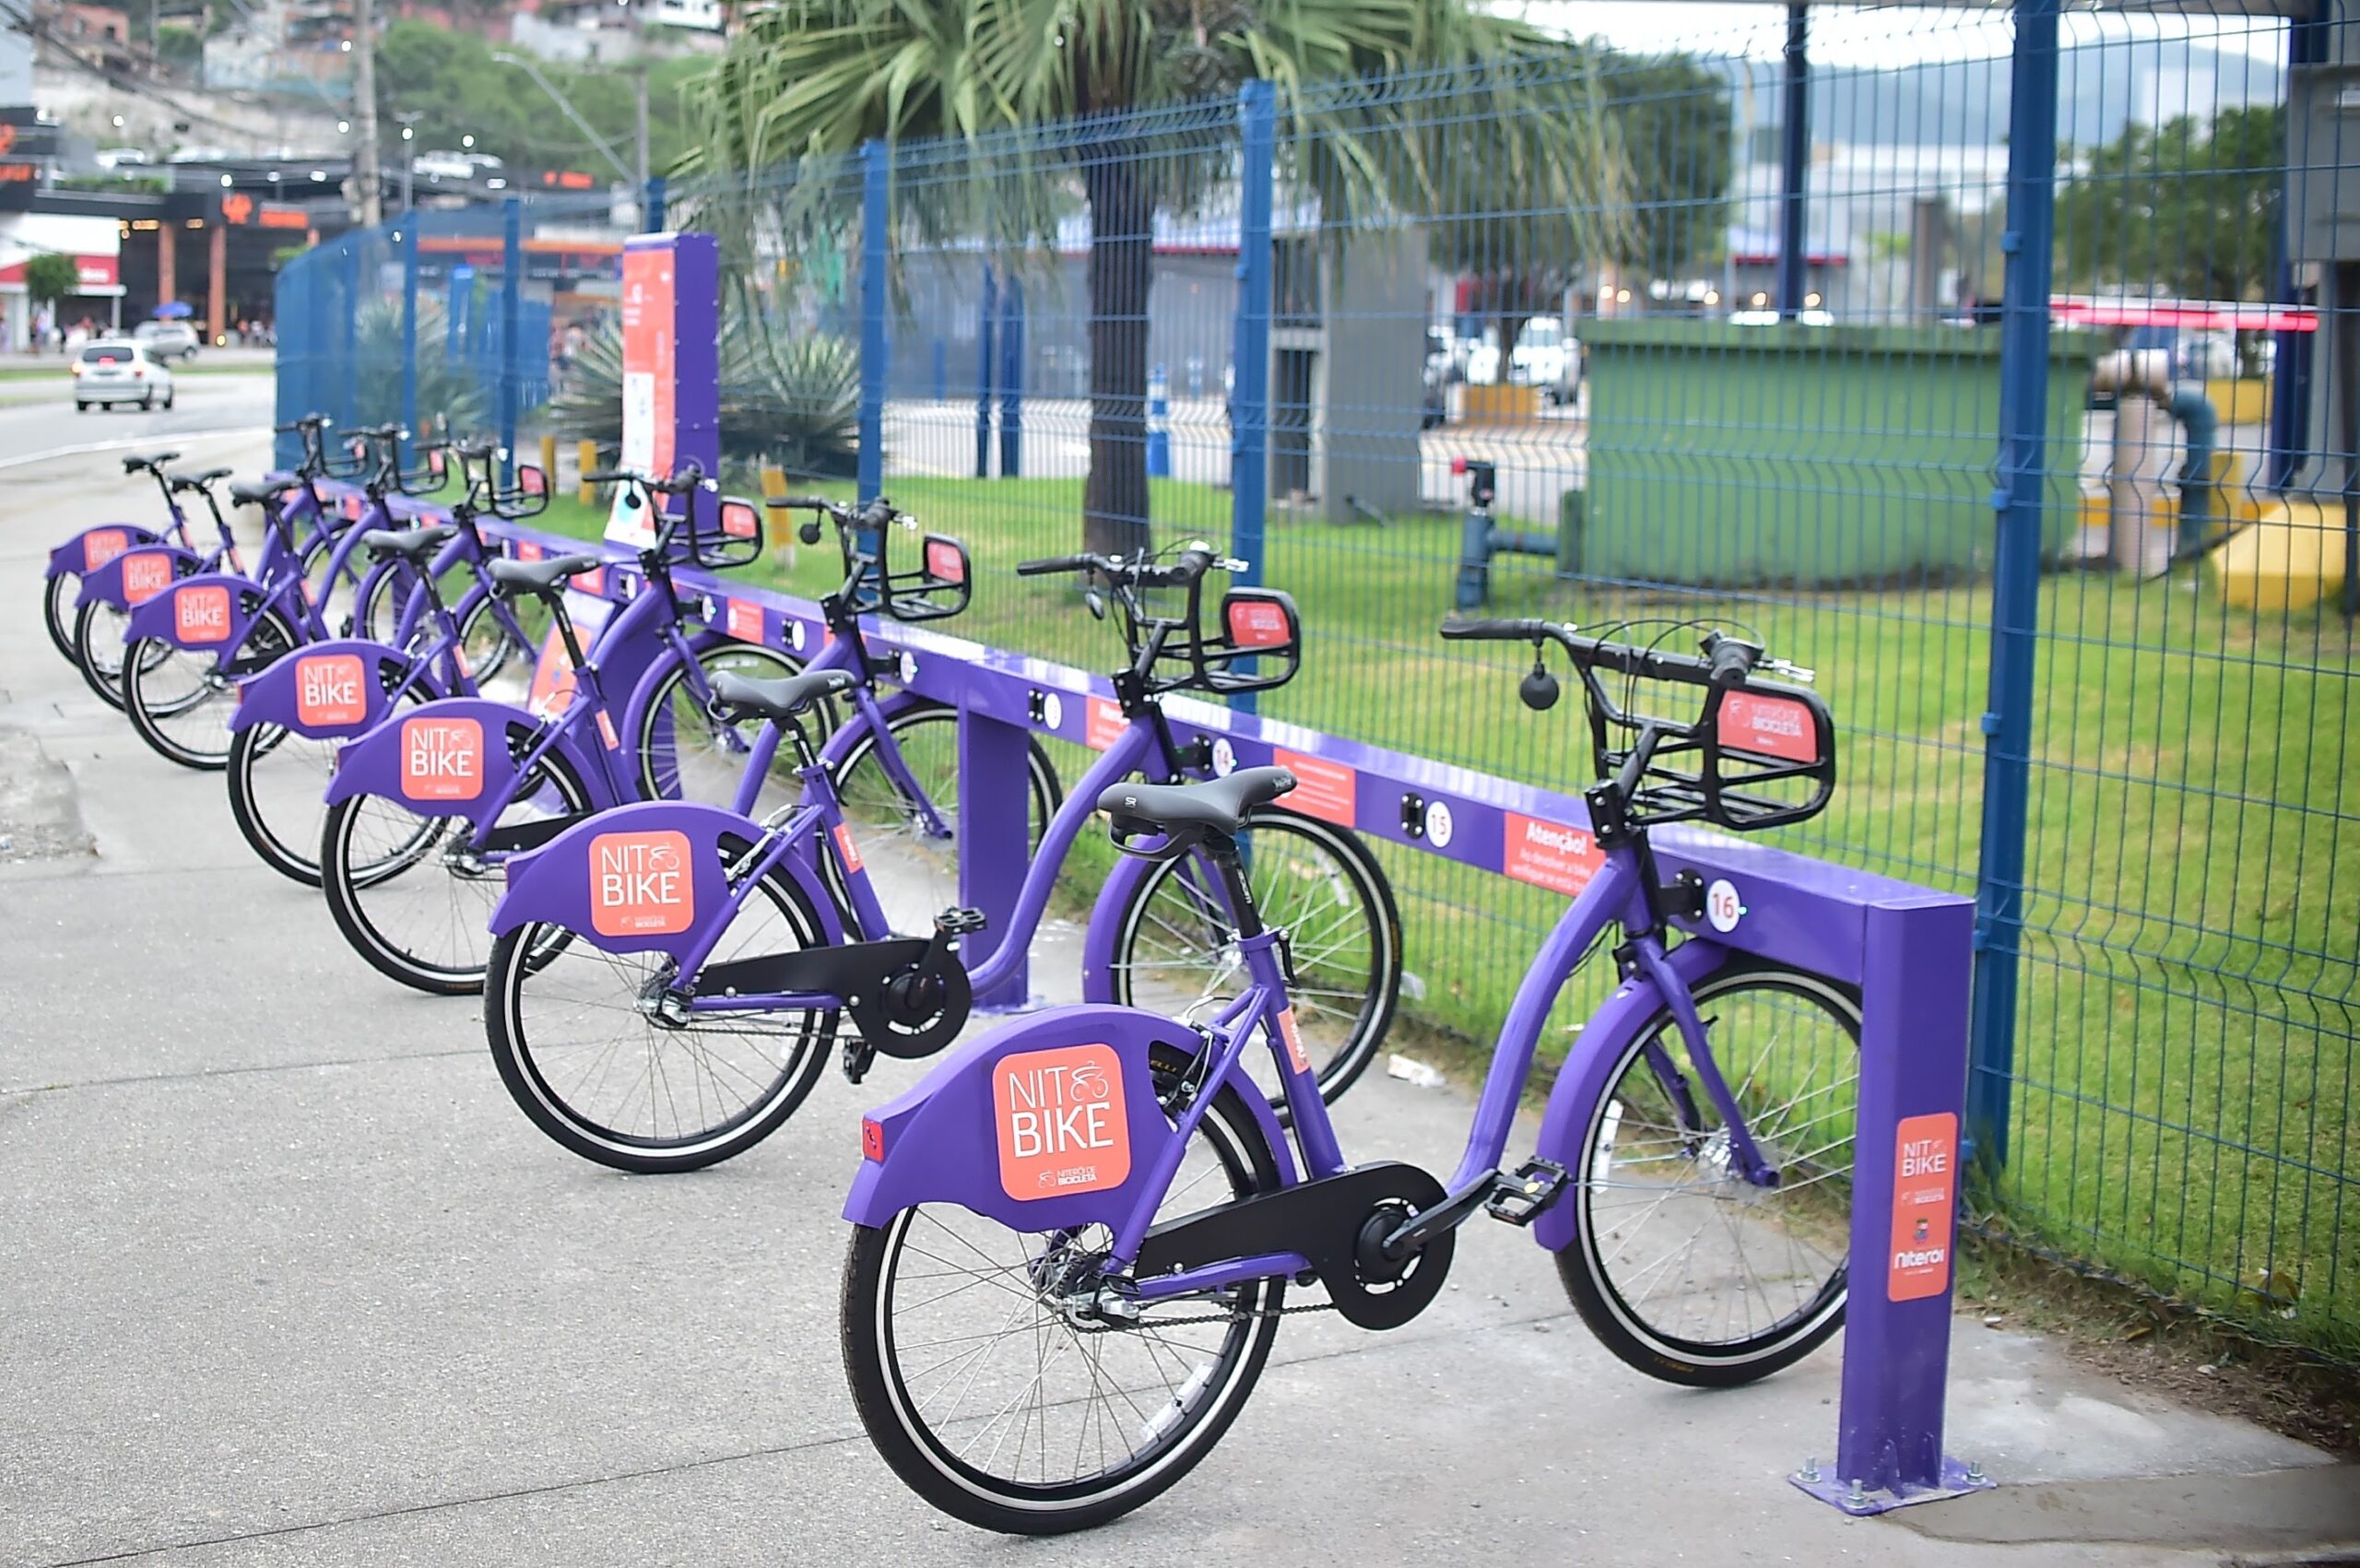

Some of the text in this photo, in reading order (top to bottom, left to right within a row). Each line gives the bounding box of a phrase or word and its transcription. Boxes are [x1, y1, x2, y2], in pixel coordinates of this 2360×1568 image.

[182, 607, 223, 628] BIKE
[303, 664, 335, 684] NIT
[304, 682, 358, 707] BIKE
[411, 727, 449, 751] NIT
[411, 750, 475, 777] BIKE
[1431, 814, 1446, 836] 15
[1526, 819, 1587, 856] Atenção!
[601, 844, 649, 874] NIT
[602, 872, 681, 907] BIKE
[1712, 892, 1734, 919] 16
[1009, 1066, 1068, 1111] NIT
[1011, 1102, 1115, 1159] BIKE
[1903, 1139, 1932, 1158] NIT
[1902, 1153, 1947, 1177] BIKE
